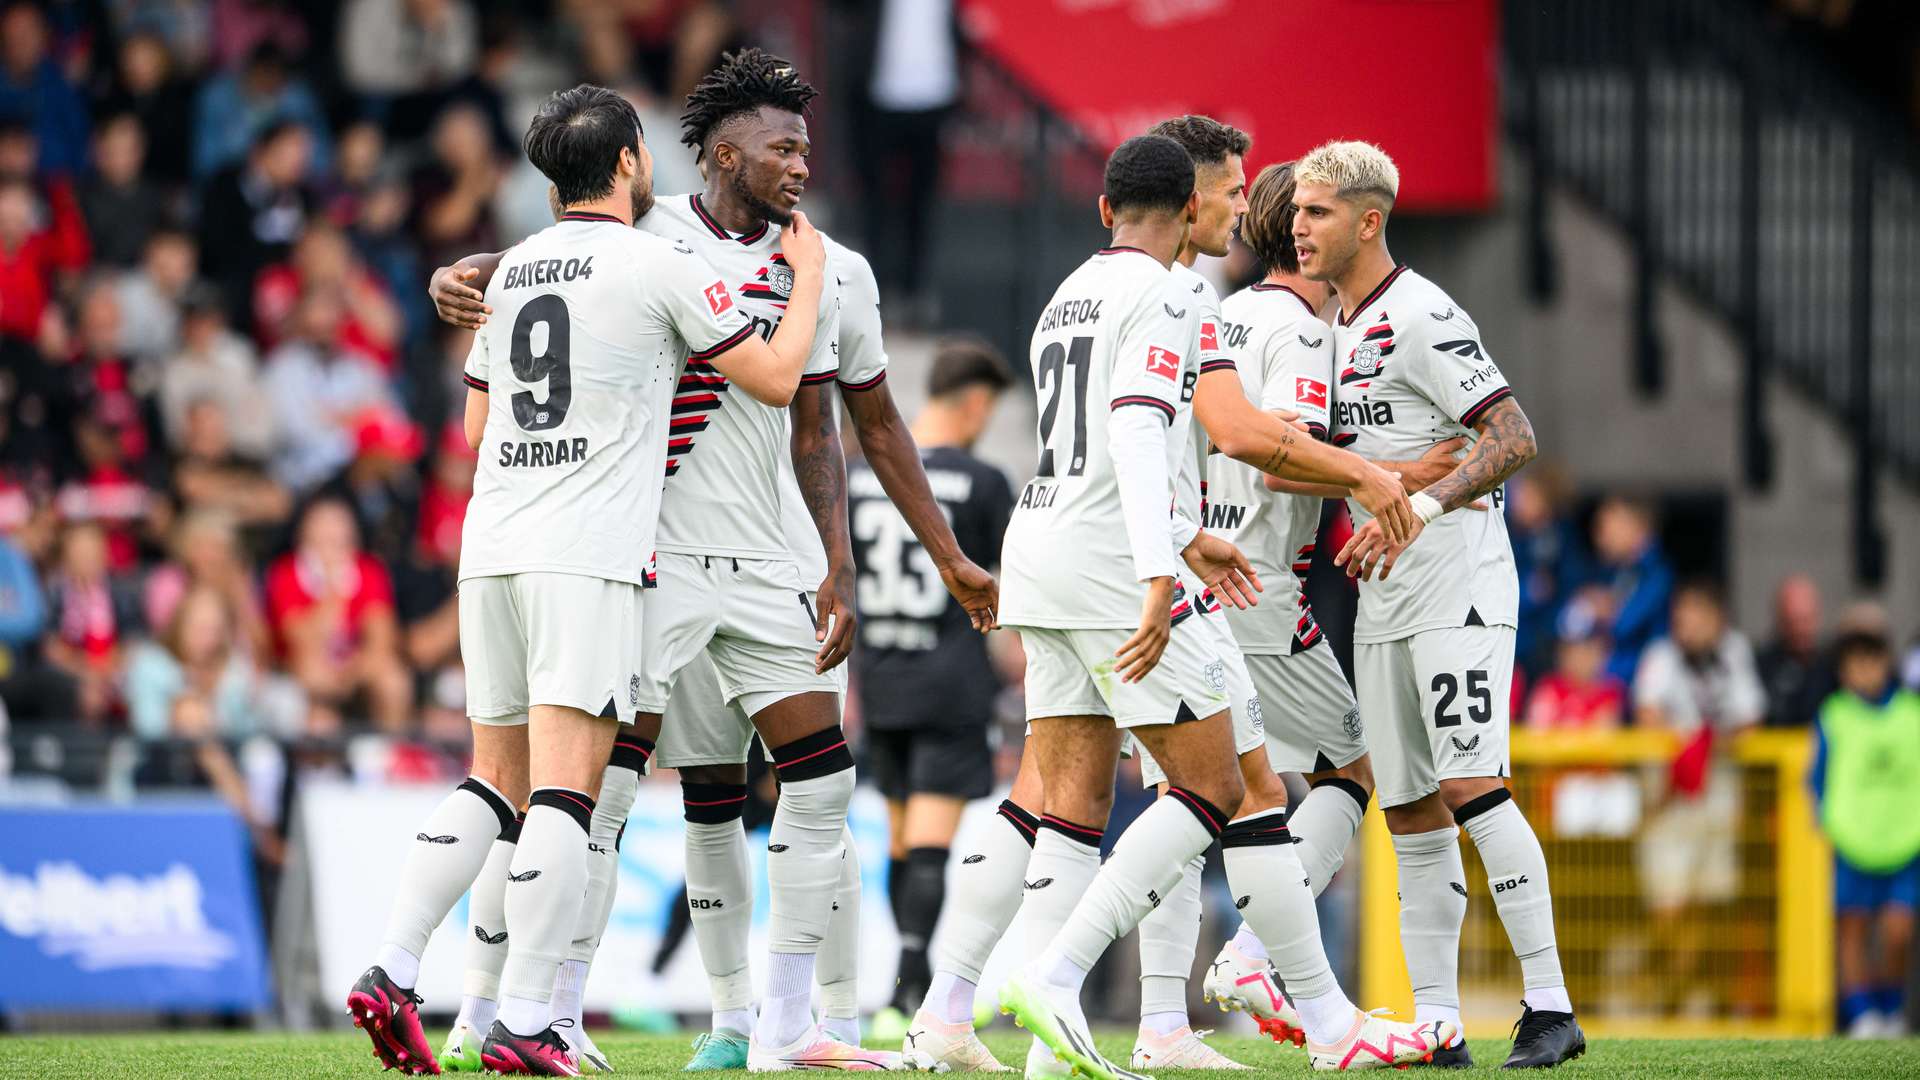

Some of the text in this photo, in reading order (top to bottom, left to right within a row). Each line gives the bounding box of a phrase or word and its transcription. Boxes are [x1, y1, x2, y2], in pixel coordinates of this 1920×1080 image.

[510, 294, 571, 431] 9
[1460, 364, 1498, 392] trive
[1180, 371, 1198, 403] B
[1036, 336, 1095, 478] 21
[499, 437, 588, 467] SARDAR
[1020, 483, 1059, 510] ADLI
[1491, 487, 1504, 509] P
[1431, 669, 1492, 728] 25
